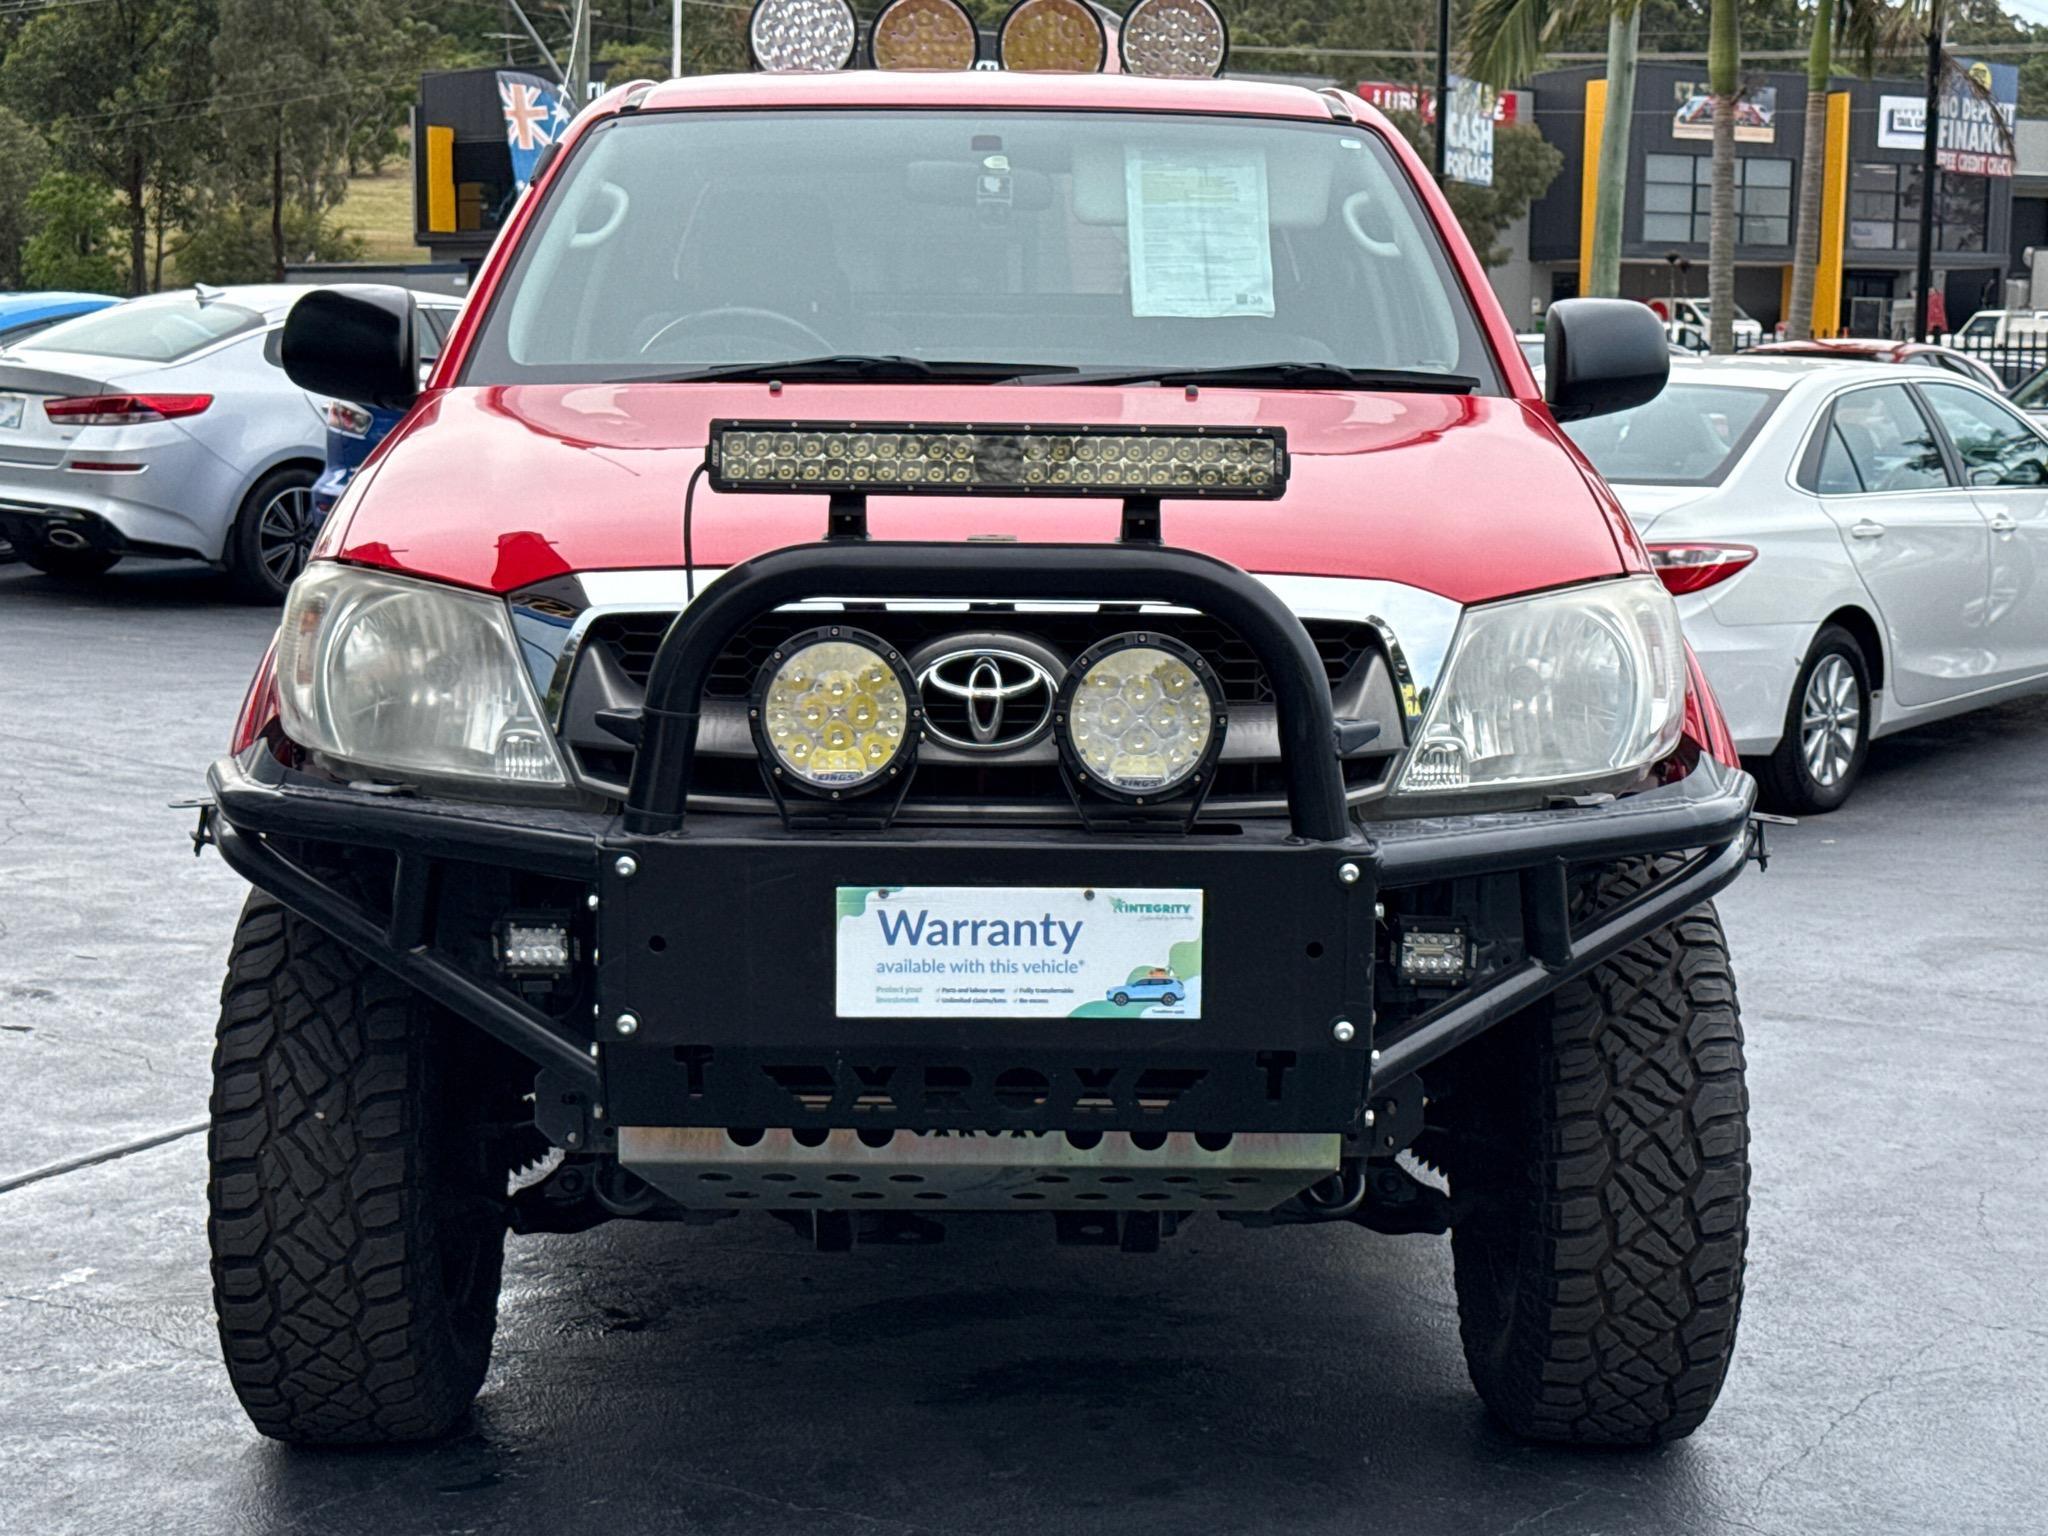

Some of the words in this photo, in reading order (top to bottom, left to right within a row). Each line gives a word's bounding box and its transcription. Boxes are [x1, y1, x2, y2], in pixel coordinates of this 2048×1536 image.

[1939, 96, 1958, 119] NO
[1962, 97, 2016, 126] DEPOIT
[1446, 113, 1494, 154] CASH
[1125, 903, 1191, 913] INTEGRITY
[877, 909, 1084, 954] Warranty
[876, 959, 946, 974] available
[951, 959, 985, 974] with
[990, 959, 1018, 974] this
